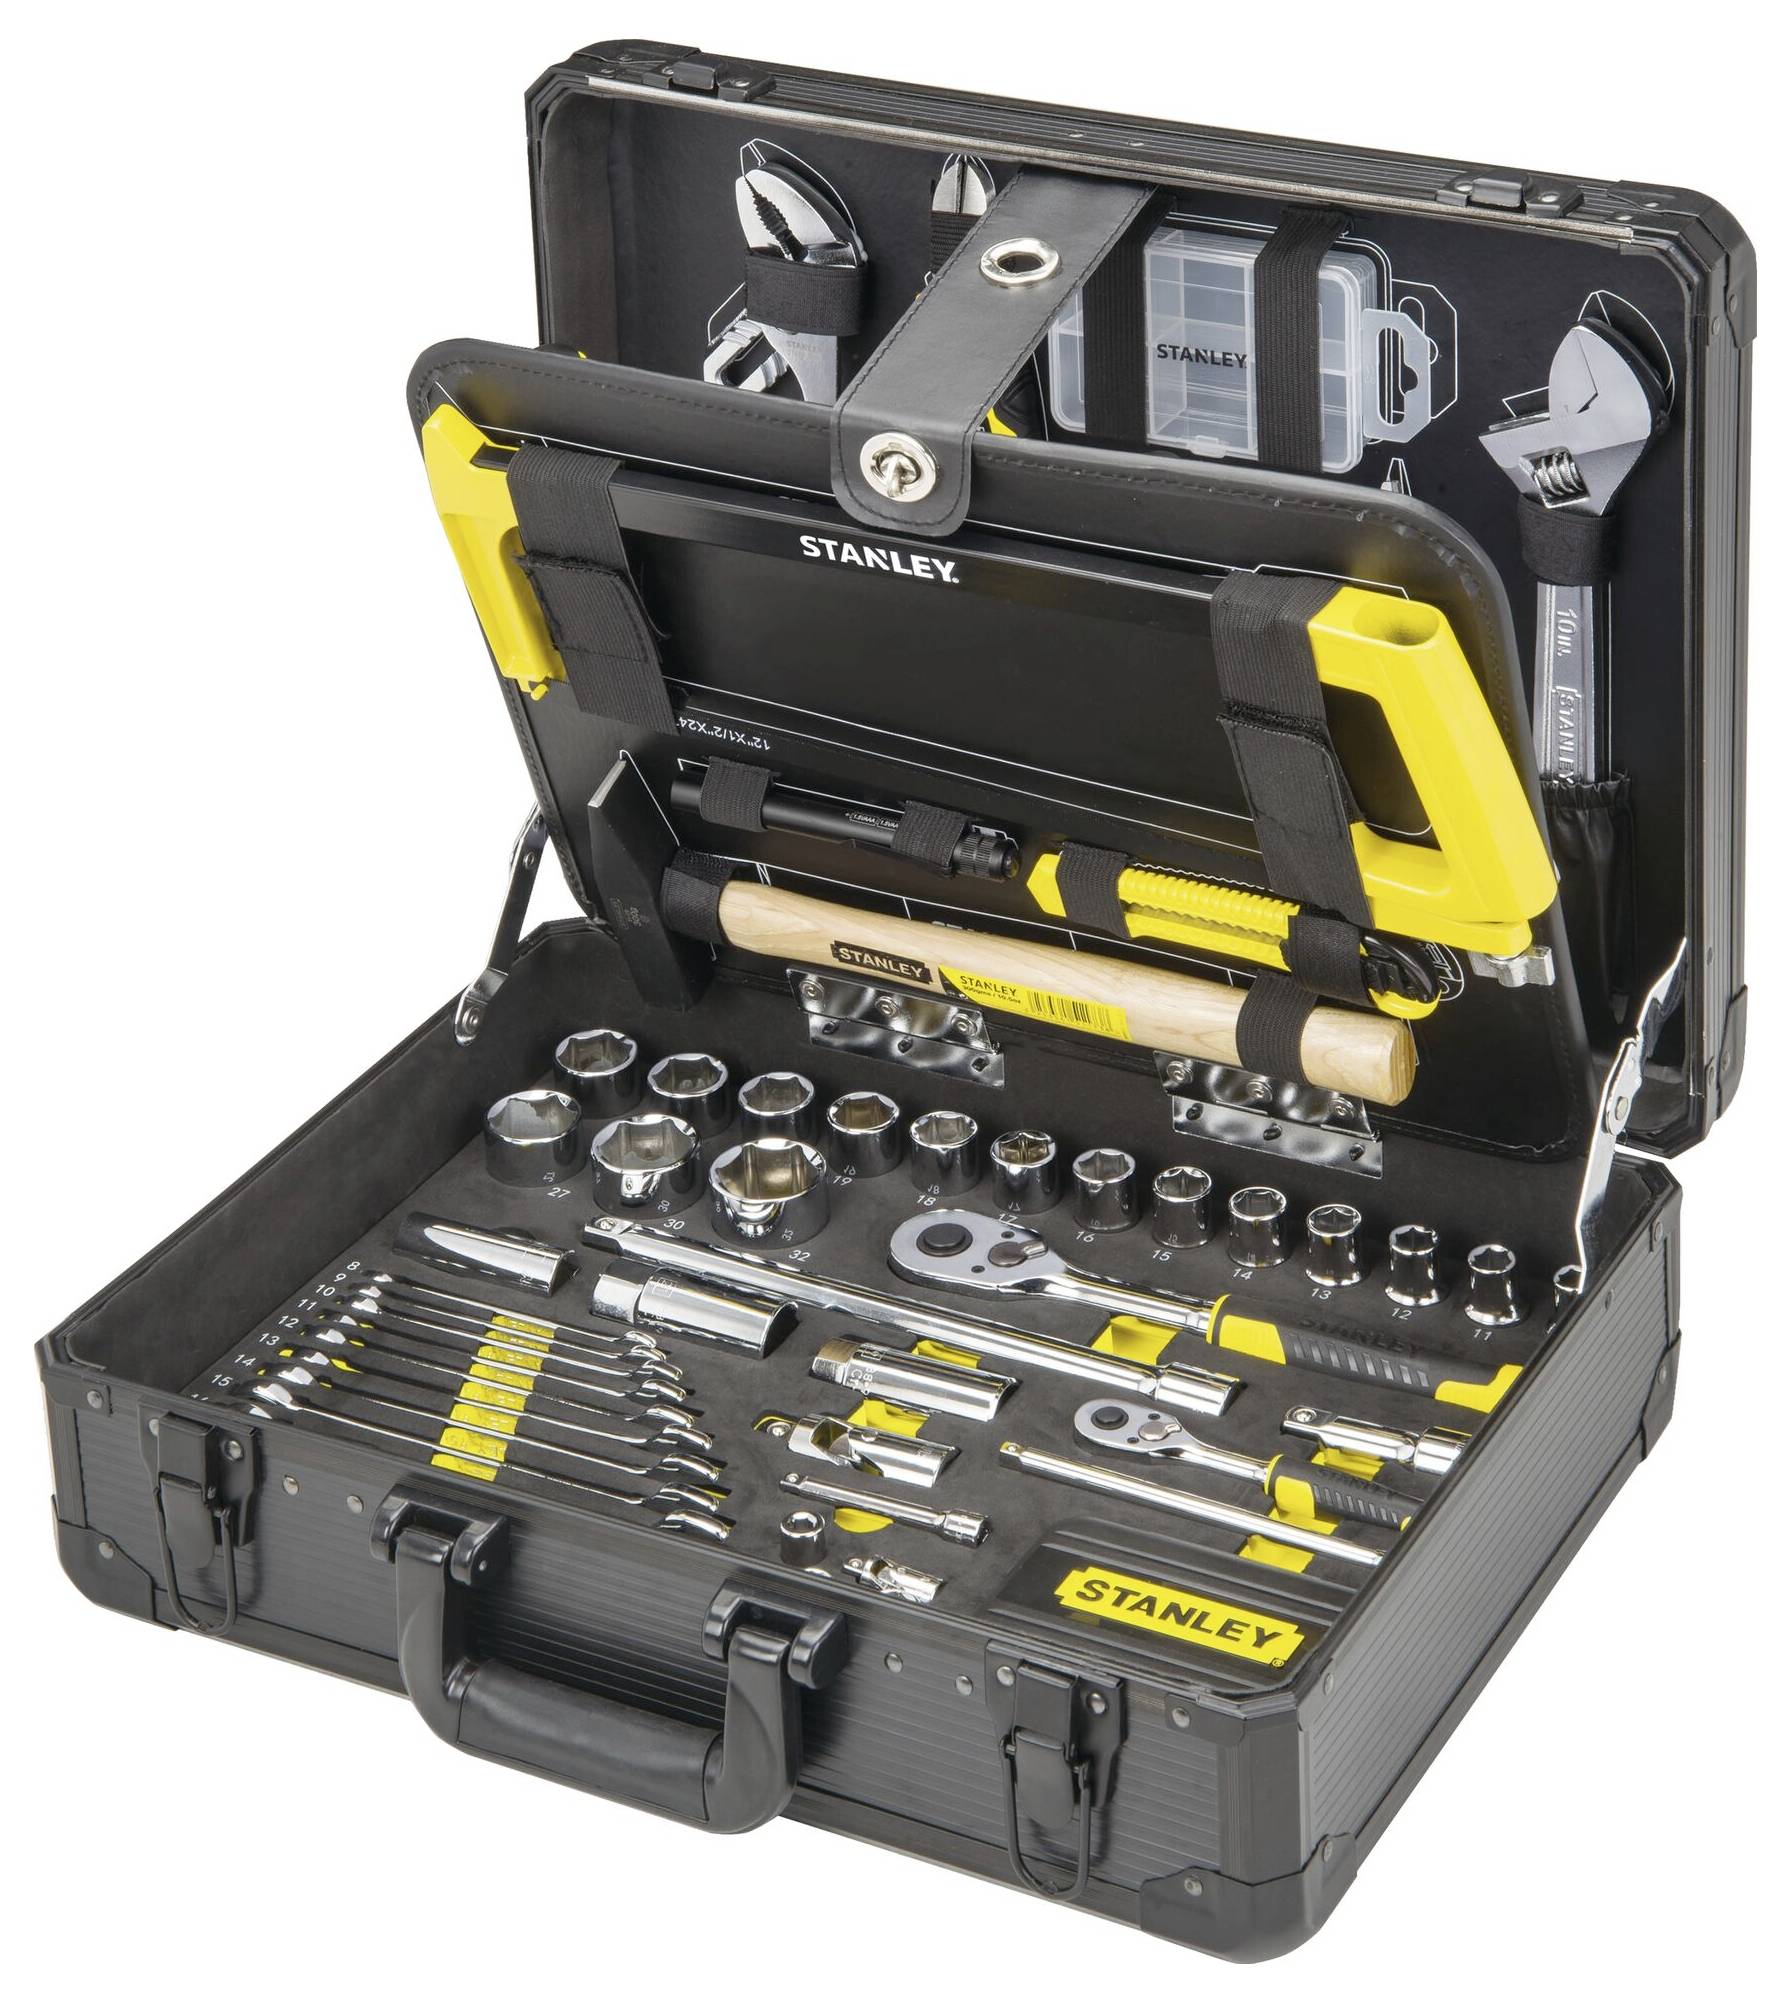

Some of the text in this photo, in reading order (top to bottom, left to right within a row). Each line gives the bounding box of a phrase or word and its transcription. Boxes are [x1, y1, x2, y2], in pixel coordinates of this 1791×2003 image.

[1157, 343, 1247, 369] STANLEY
[799, 535, 960, 584] STANLEY
[1556, 693, 1578, 785] STANLEY
[838, 947, 924, 979] STANLEY
[960, 975, 1017, 997] STANLEY
[832, 1175, 853, 1187] 19
[546, 1186, 572, 1199] 27
[916, 1194, 937, 1207] 18
[662, 1218, 686, 1231] 30
[999, 1212, 1019, 1224] 17
[1075, 1230, 1096, 1243] 16
[788, 1249, 812, 1263] 32
[1151, 1248, 1173, 1262] 15
[346, 1261, 361, 1271] 8
[333, 1272, 347, 1283] 9
[1231, 1267, 1254, 1281] 14
[314, 1283, 336, 1297] 10
[1311, 1287, 1332, 1300] 13
[298, 1298, 318, 1311] 11
[1391, 1307, 1413, 1321] 12
[278, 1314, 300, 1329] 12
[258, 1332, 281, 1346] 13
[1472, 1327, 1494, 1341] 11
[233, 1353, 257, 1368] 14
[210, 1373, 234, 1388] 15
[1075, 1579, 1283, 1649] STANLEY
